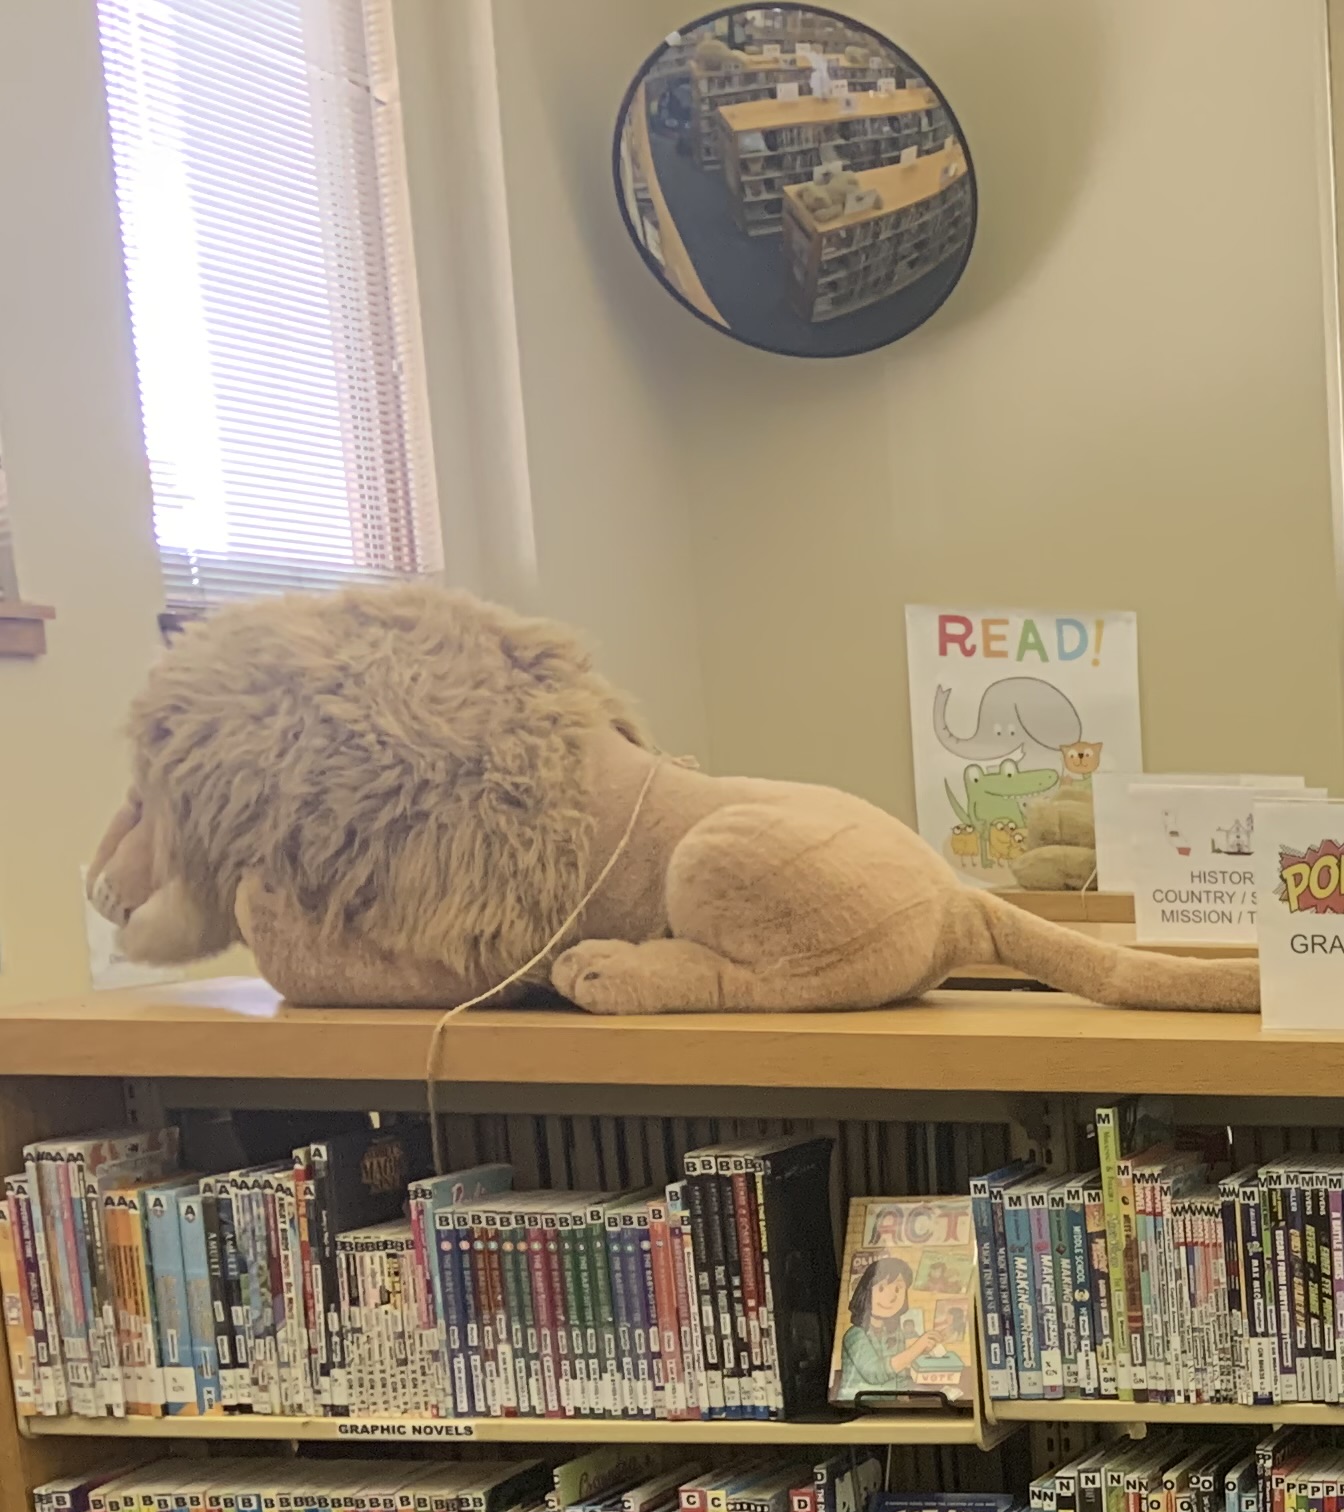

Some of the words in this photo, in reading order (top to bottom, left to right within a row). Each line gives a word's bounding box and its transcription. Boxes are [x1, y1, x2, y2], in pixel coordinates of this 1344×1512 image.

[937, 613, 1105, 668] READ!
[1190, 870, 1254, 887] HISTOR
[1152, 889, 1235, 905] COUNTRY
[1160, 909, 1230, 925] MISSION
[868, 1204, 970, 1246] ACT
[338, 1423, 409, 1436] GRAPHIC
[414, 1424, 473, 1437] NOVELS
